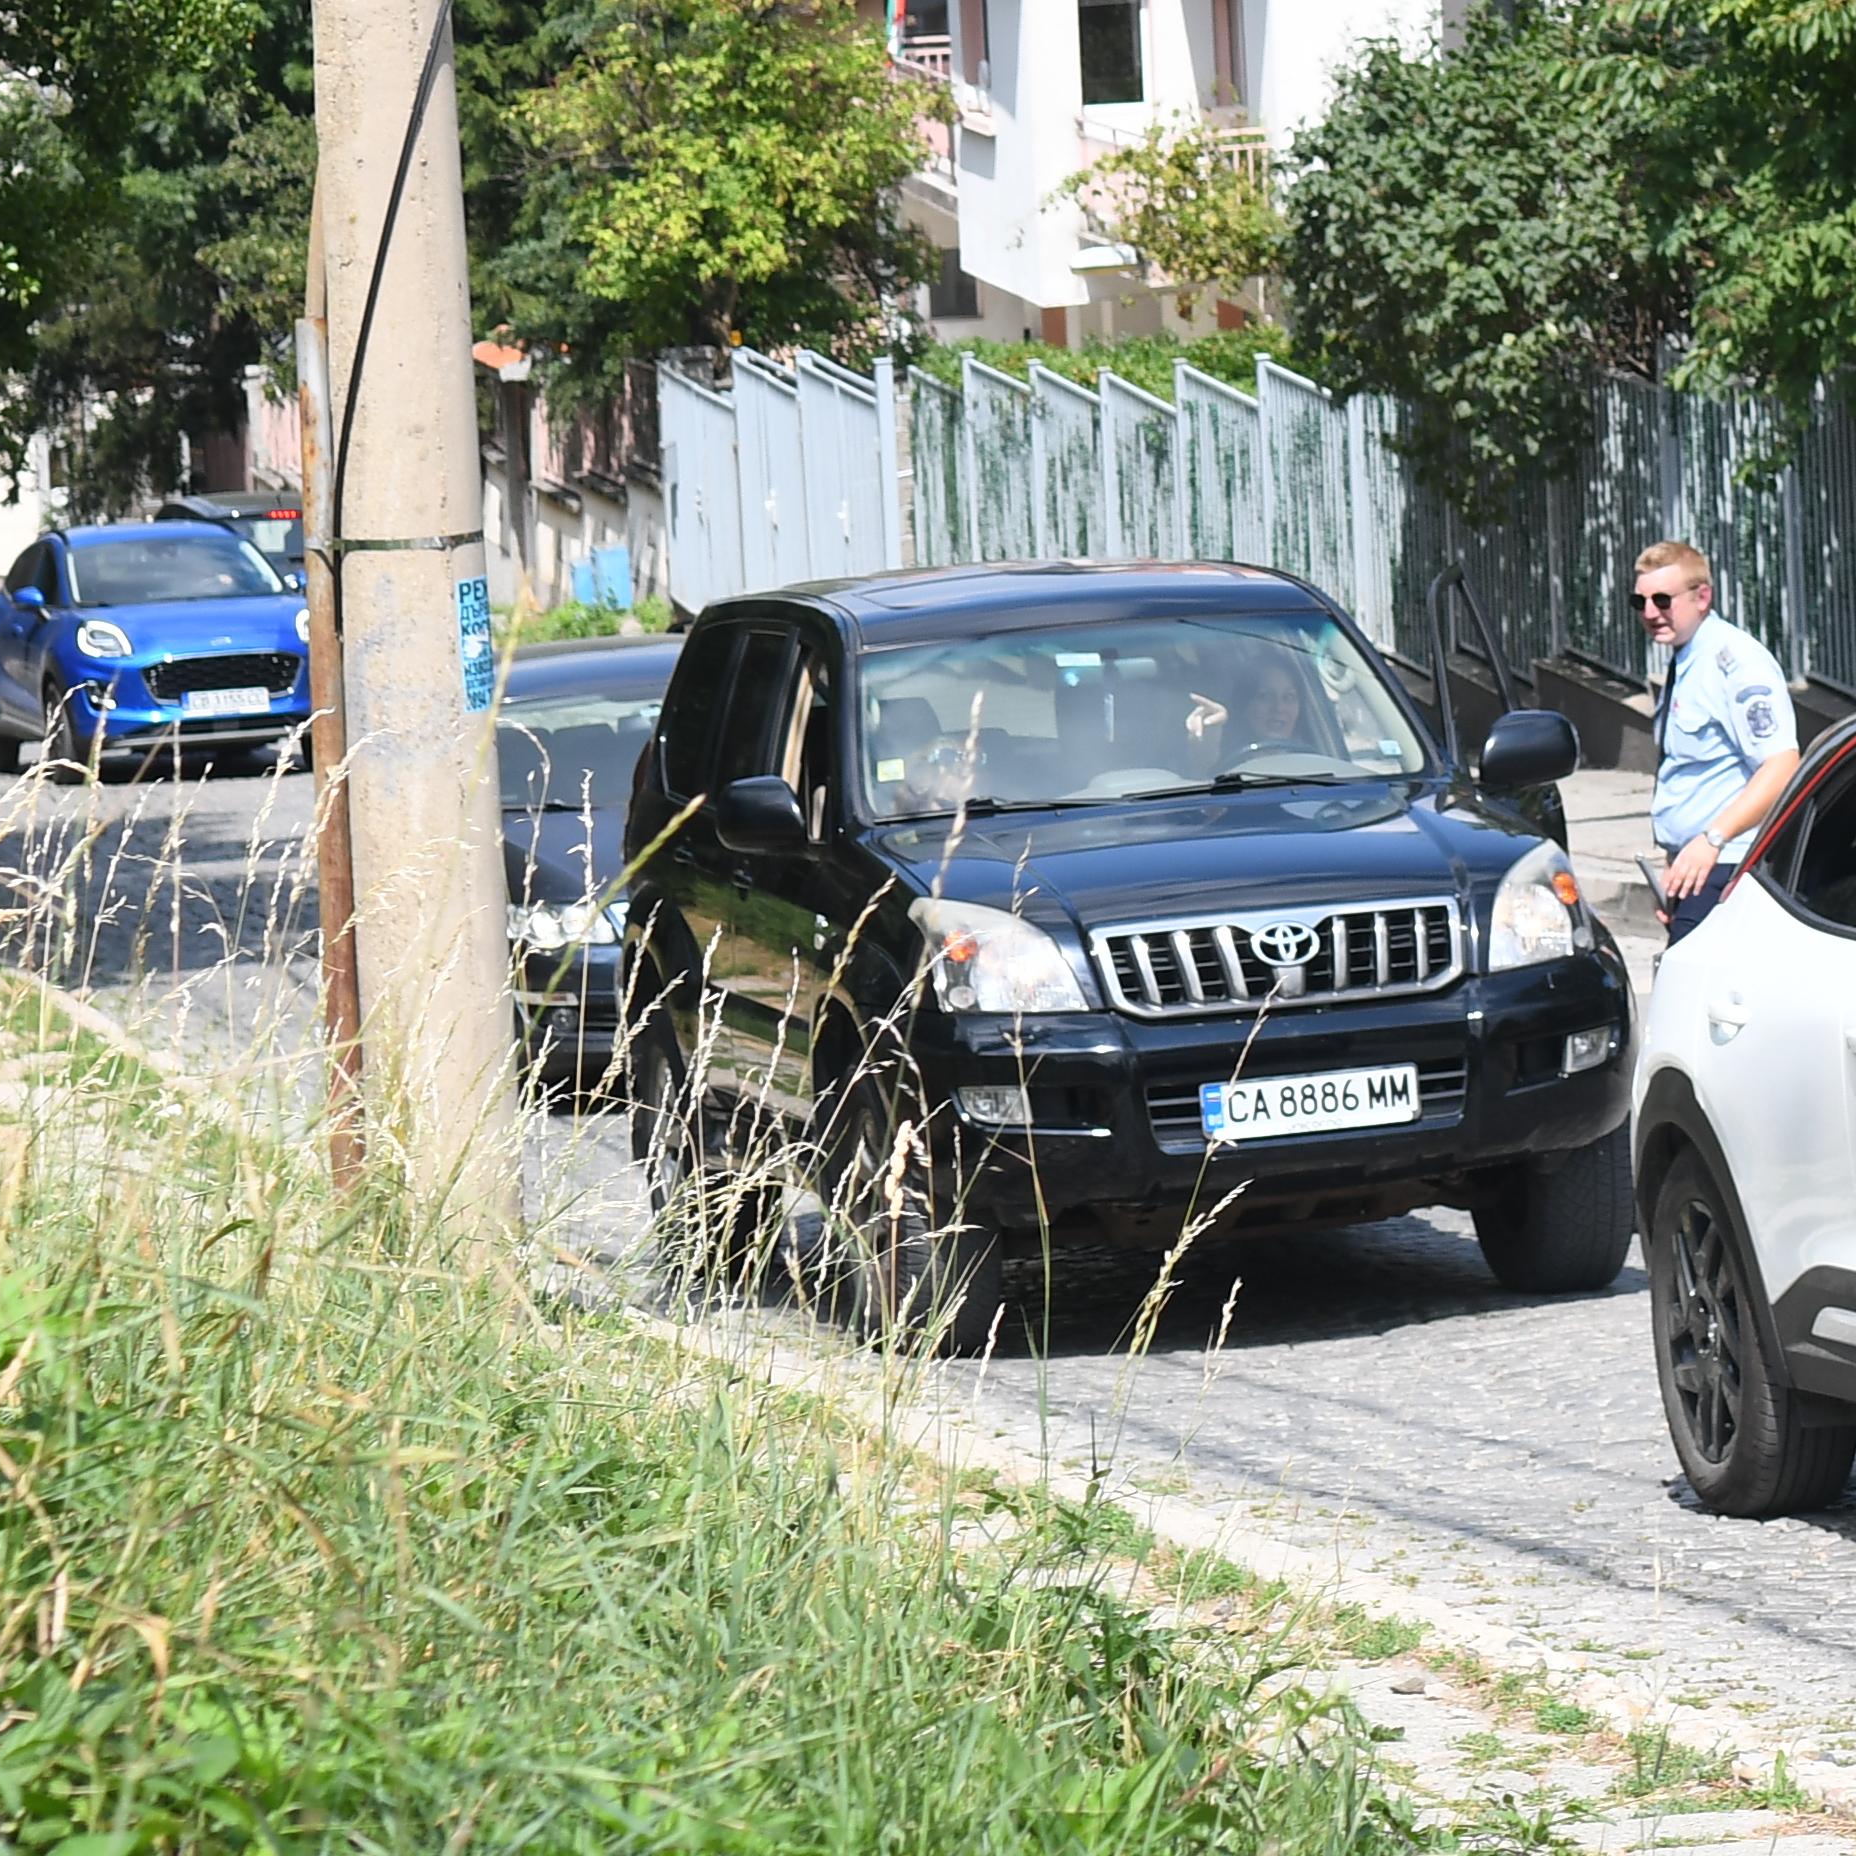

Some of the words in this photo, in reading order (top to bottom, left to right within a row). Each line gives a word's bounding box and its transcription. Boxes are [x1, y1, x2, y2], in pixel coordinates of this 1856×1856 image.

[1228, 1088, 1271, 1123] CA
[1279, 1079, 1360, 1118] 8886
[1367, 1073, 1411, 1110] MM
